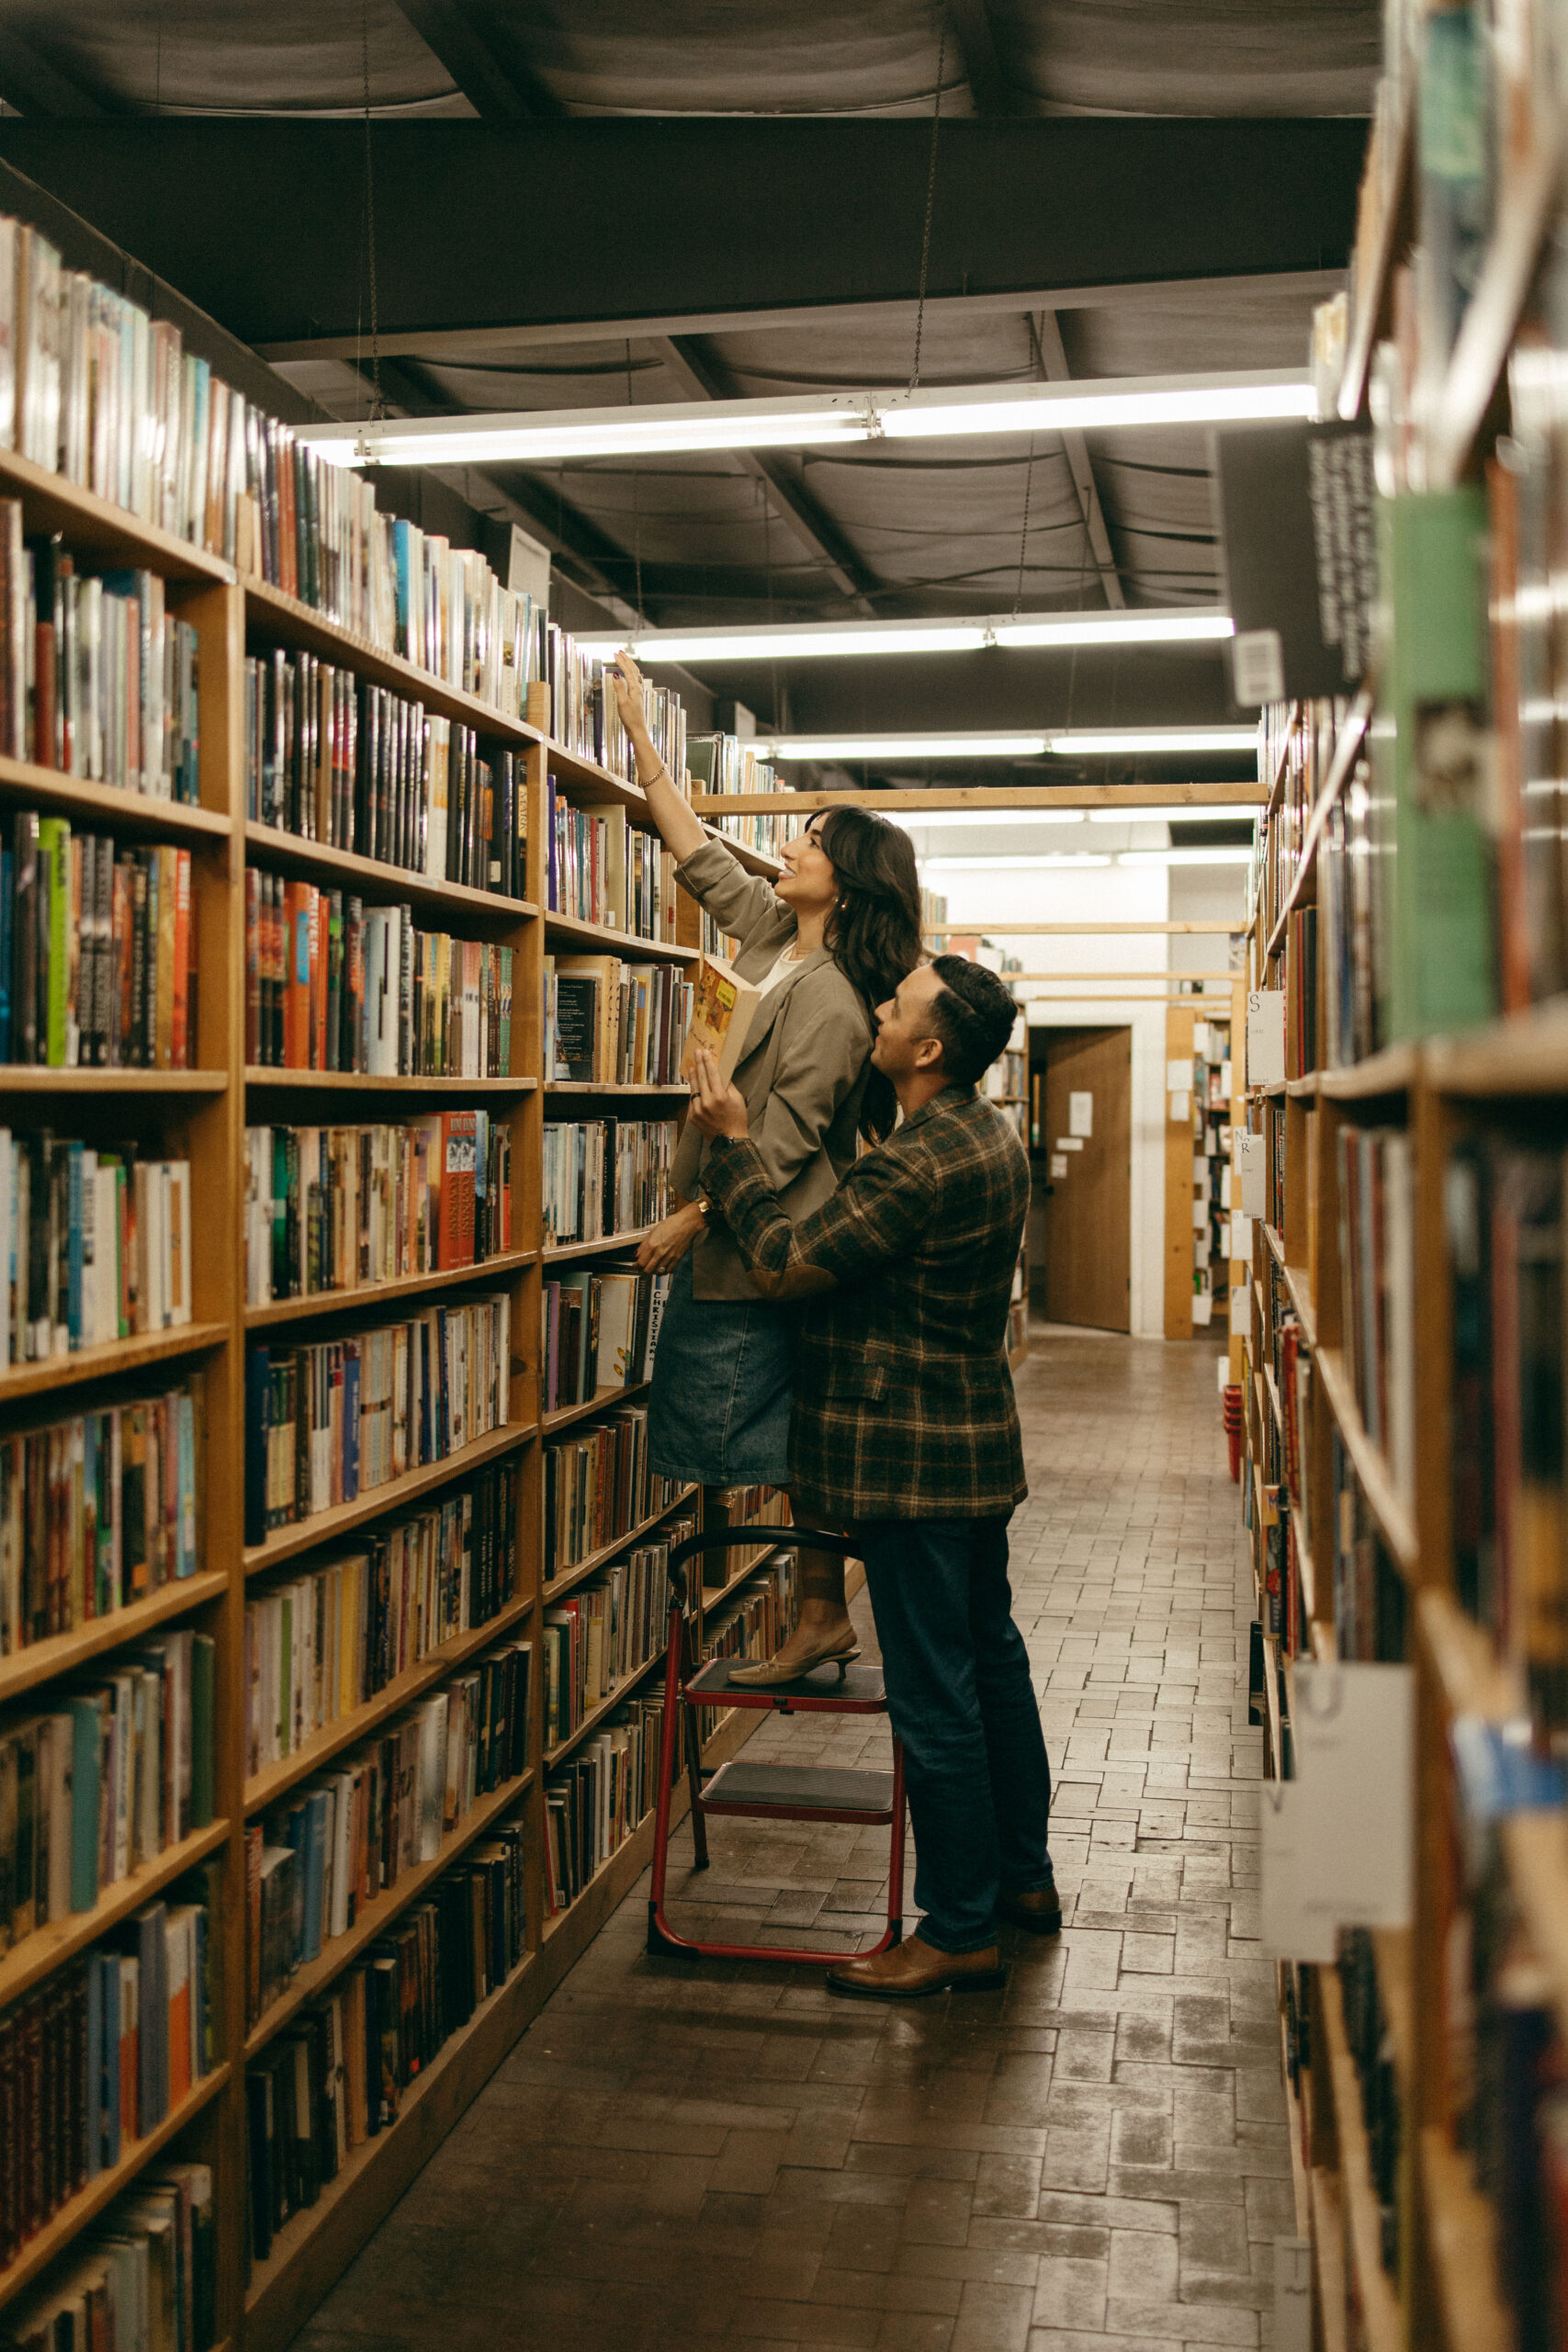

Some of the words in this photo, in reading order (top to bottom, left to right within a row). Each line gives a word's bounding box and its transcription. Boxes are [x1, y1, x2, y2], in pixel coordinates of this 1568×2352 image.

[1249, 994, 1260, 1012] S
[1241, 1142, 1250, 1154] R
[463, 1173, 471, 1237] COVENANT
[649, 1291, 661, 1354] CHRISTIAN
